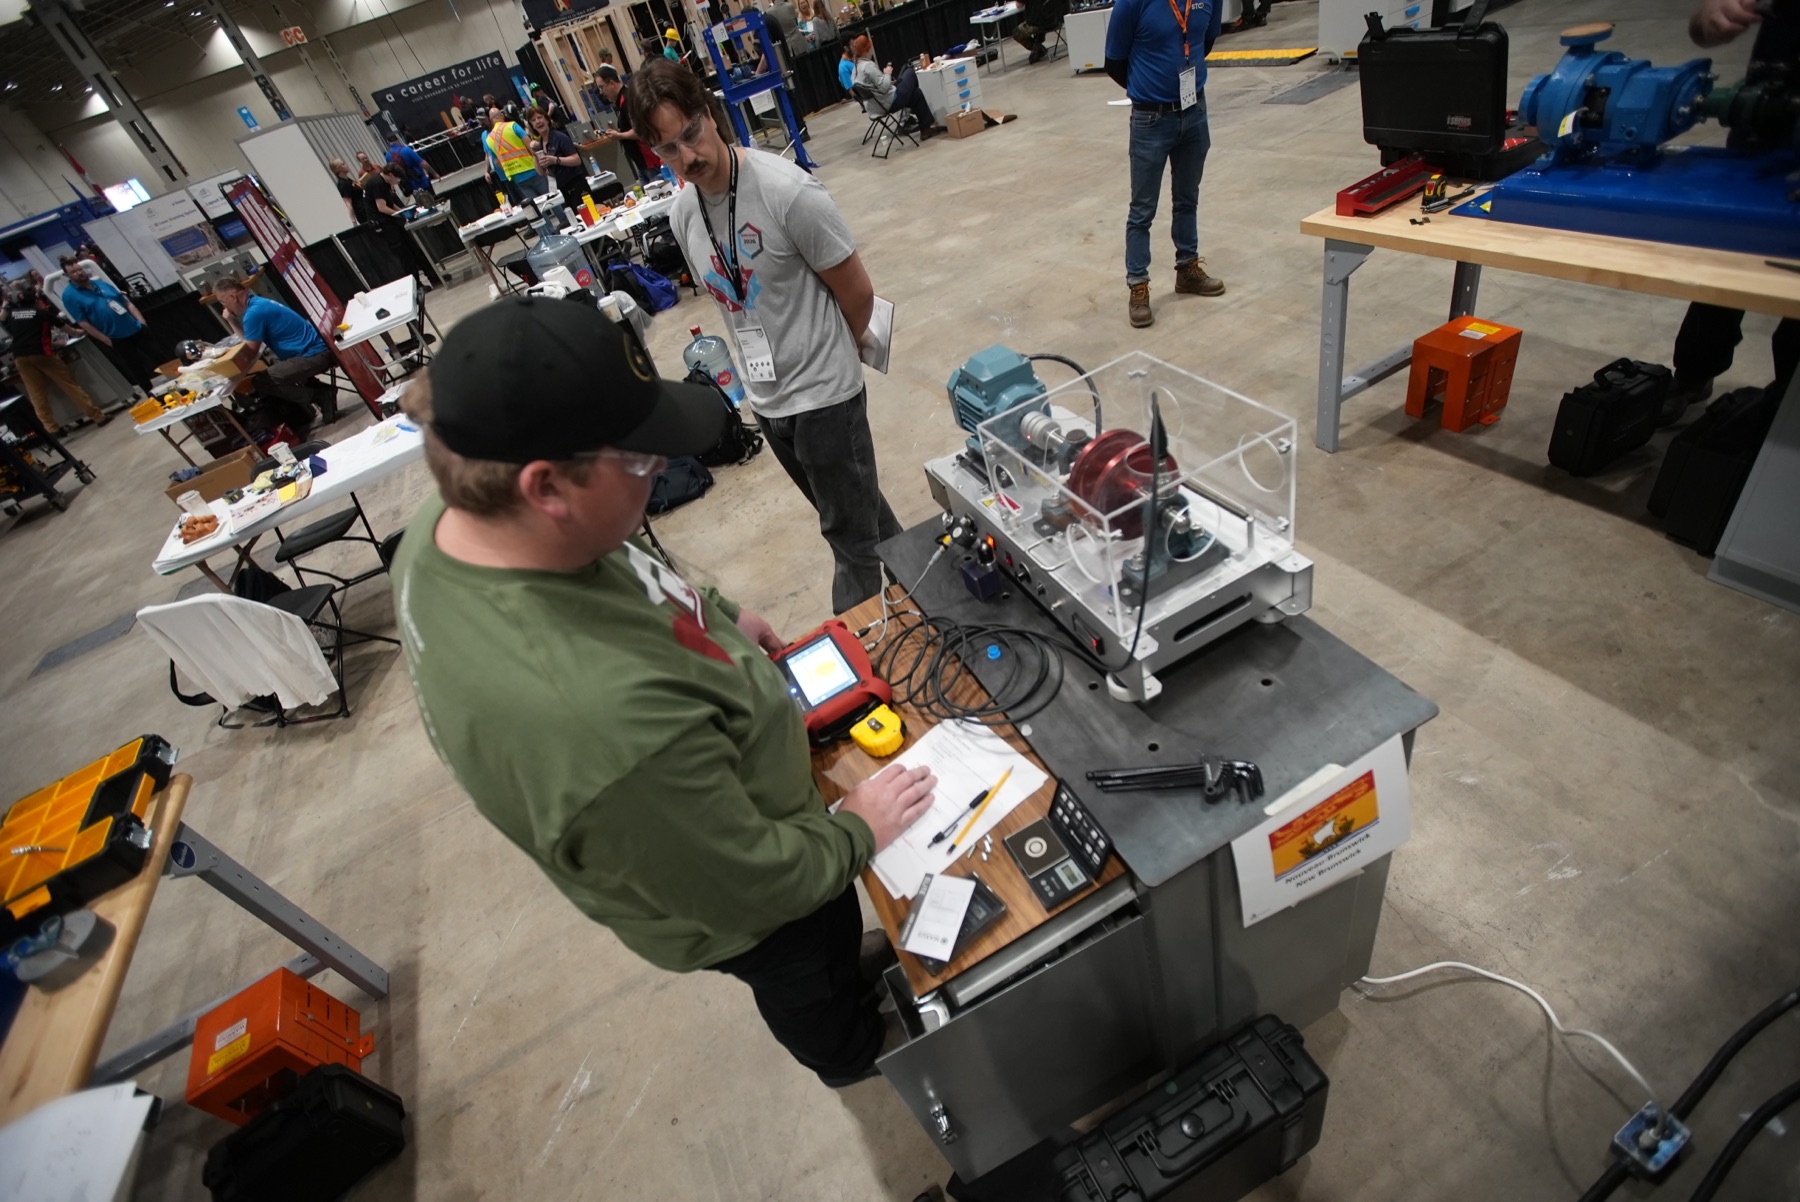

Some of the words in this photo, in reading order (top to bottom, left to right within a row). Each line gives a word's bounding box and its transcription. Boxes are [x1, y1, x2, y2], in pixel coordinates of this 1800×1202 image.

[385, 93, 395, 102] a
[400, 74, 447, 97] career
[451, 65, 472, 80] for
[475, 56, 500, 72] life
[1285, 833, 1371, 885] Nouveau-Brunswick
[1296, 874, 1317, 888] New
[1318, 848, 1362, 876] Brunswick
